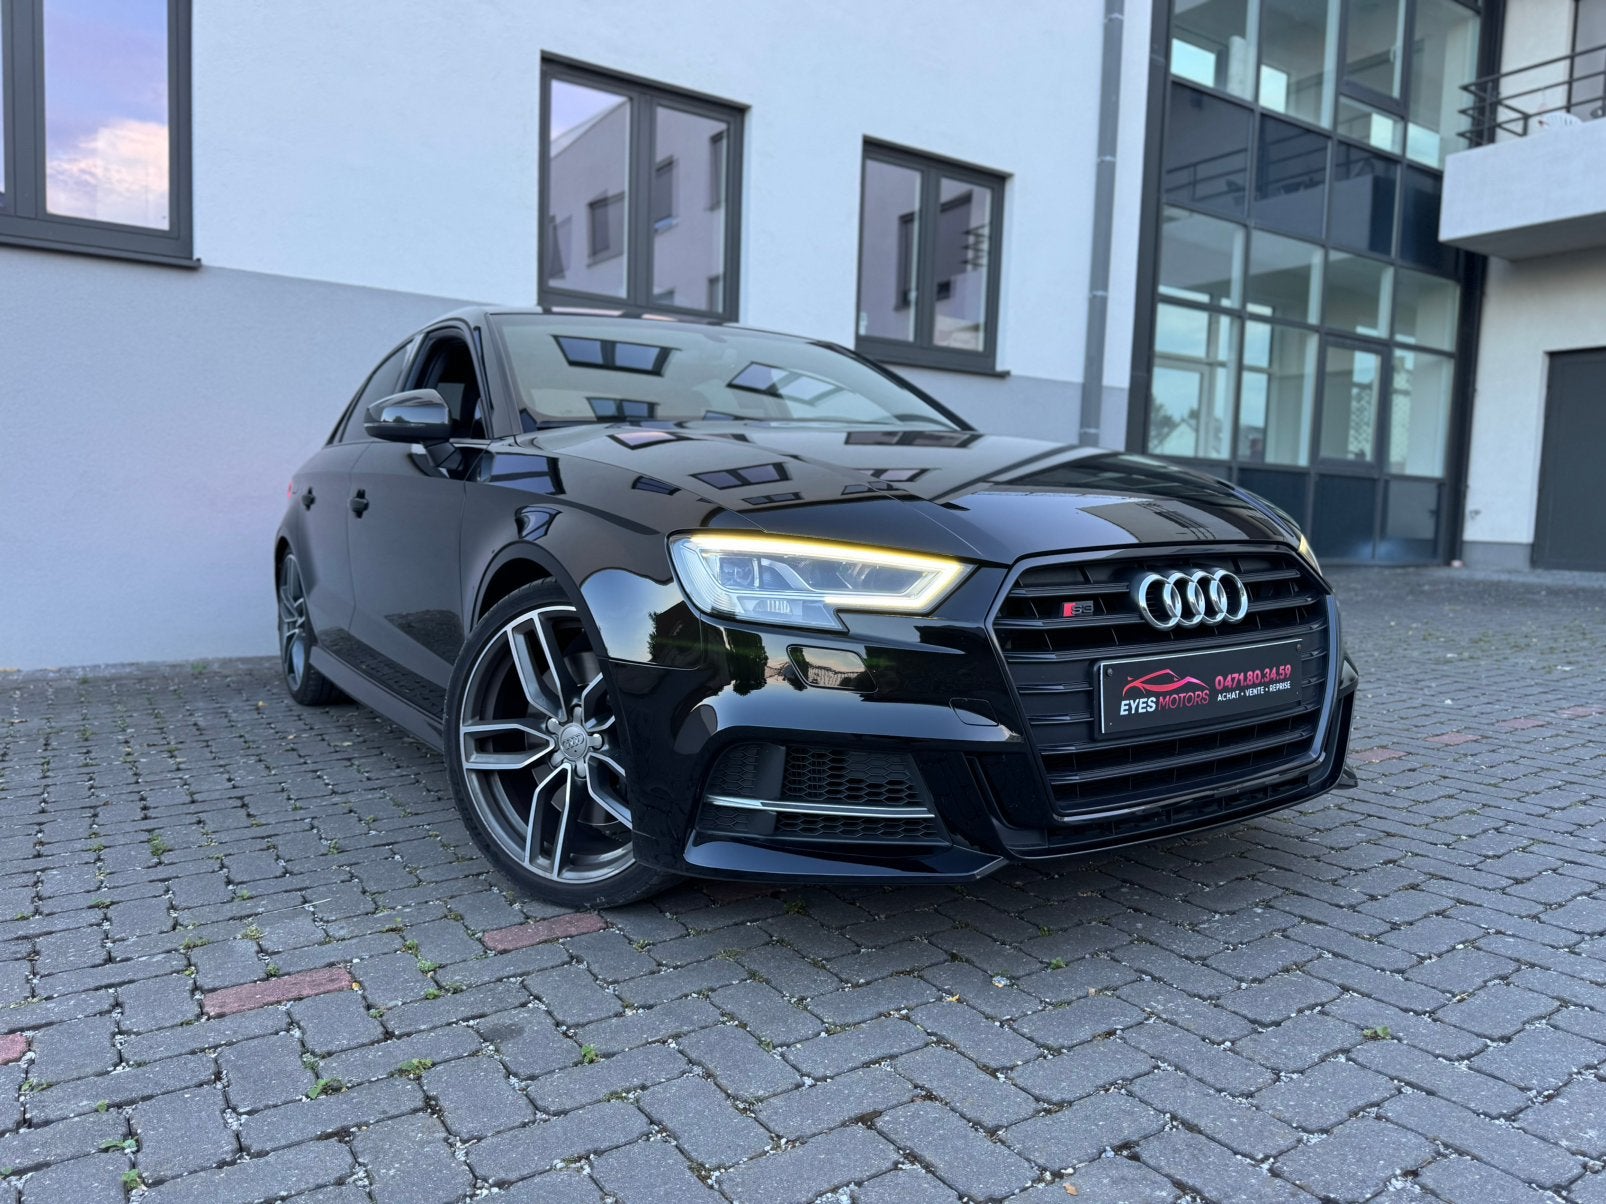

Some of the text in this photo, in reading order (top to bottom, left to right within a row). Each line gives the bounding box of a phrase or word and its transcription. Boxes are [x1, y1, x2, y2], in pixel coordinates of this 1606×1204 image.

[1215, 664, 1292, 691] 0471.80.34.59
[1120, 689, 1210, 715] EYES MOTORS
[1217, 681, 1291, 702] ACHAT VENTE REPRISE
